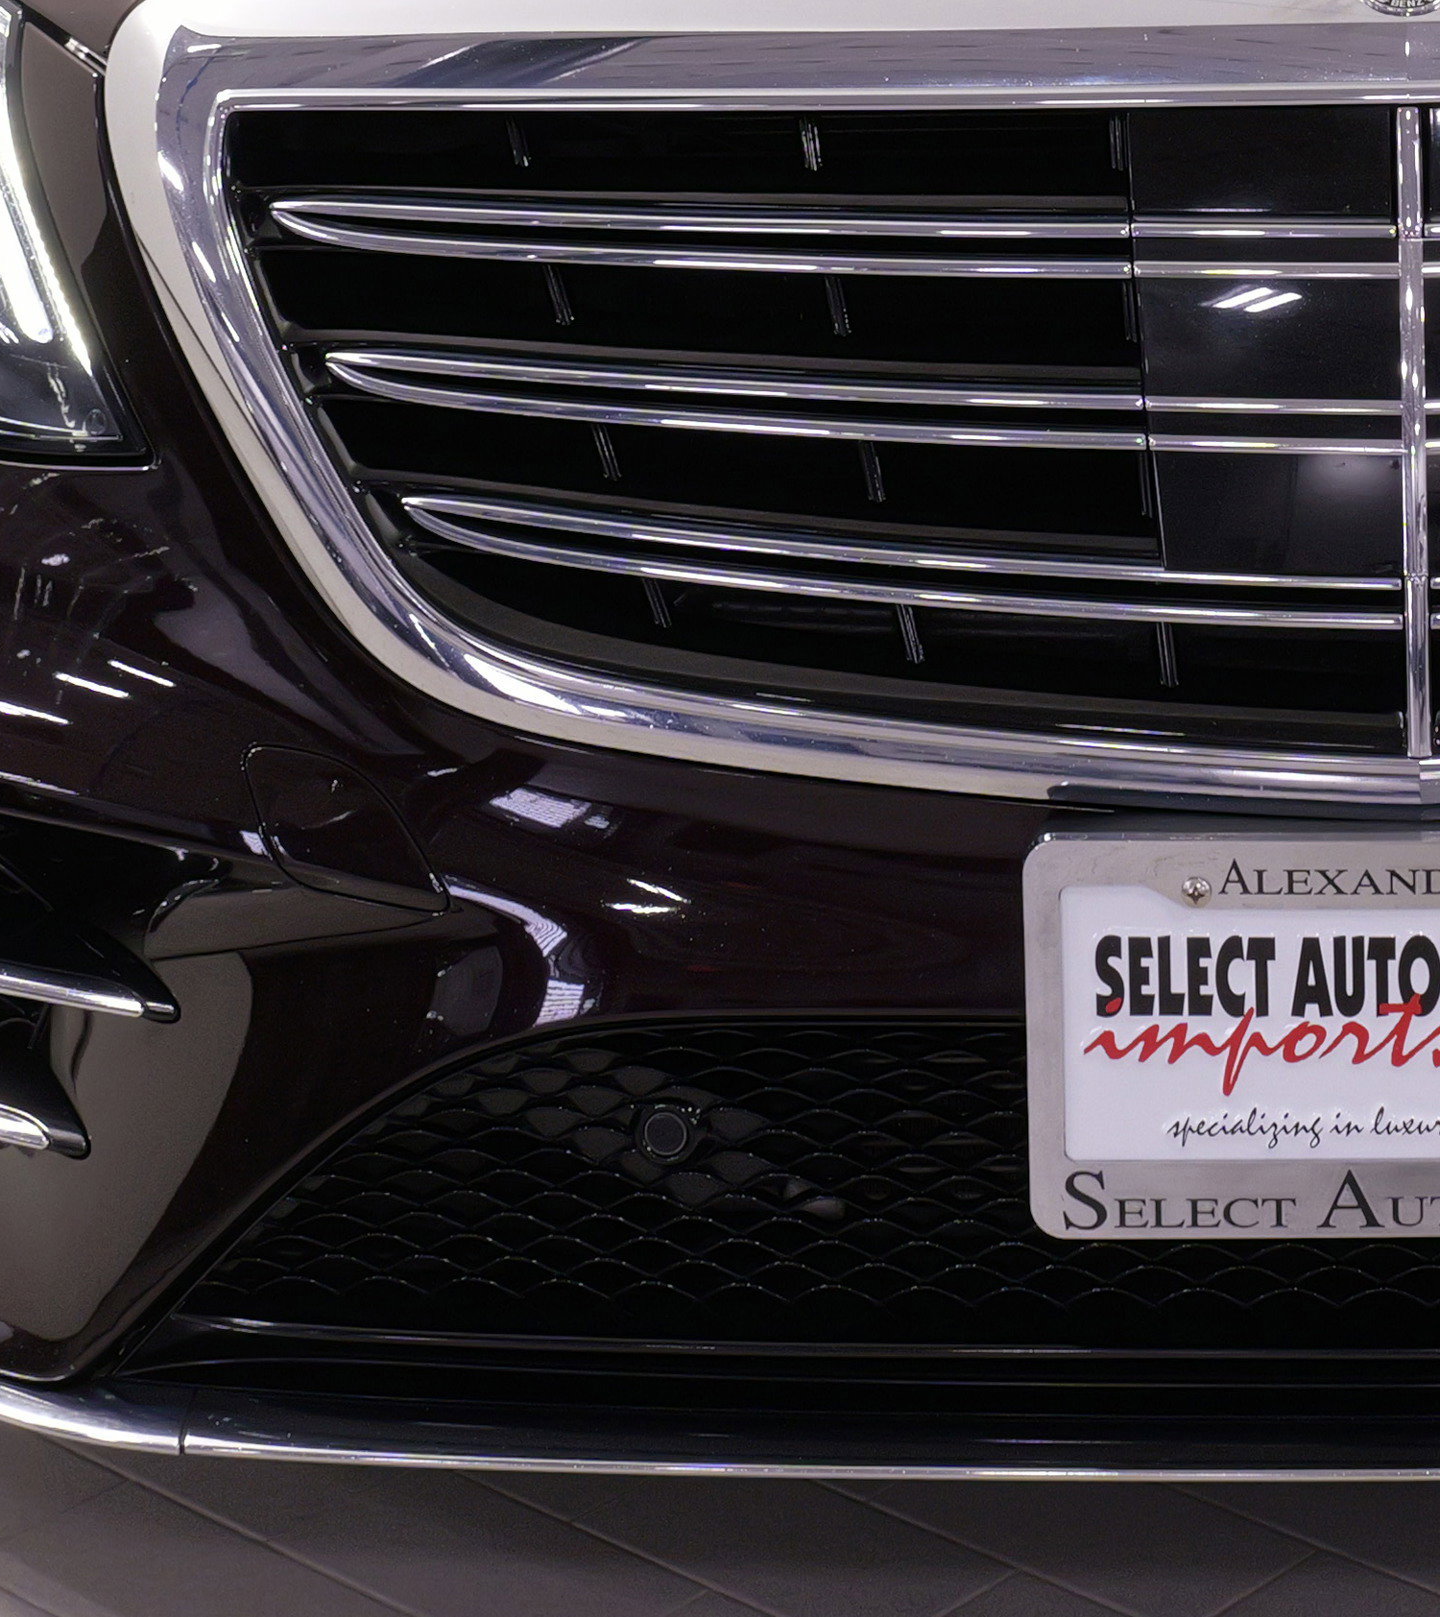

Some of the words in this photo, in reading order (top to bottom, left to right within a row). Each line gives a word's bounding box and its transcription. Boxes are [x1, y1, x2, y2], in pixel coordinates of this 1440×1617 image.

[1094, 934, 1276, 1018] SELECT
[1166, 1107, 1324, 1149] specializing
[1329, 1111, 1364, 1137] in
